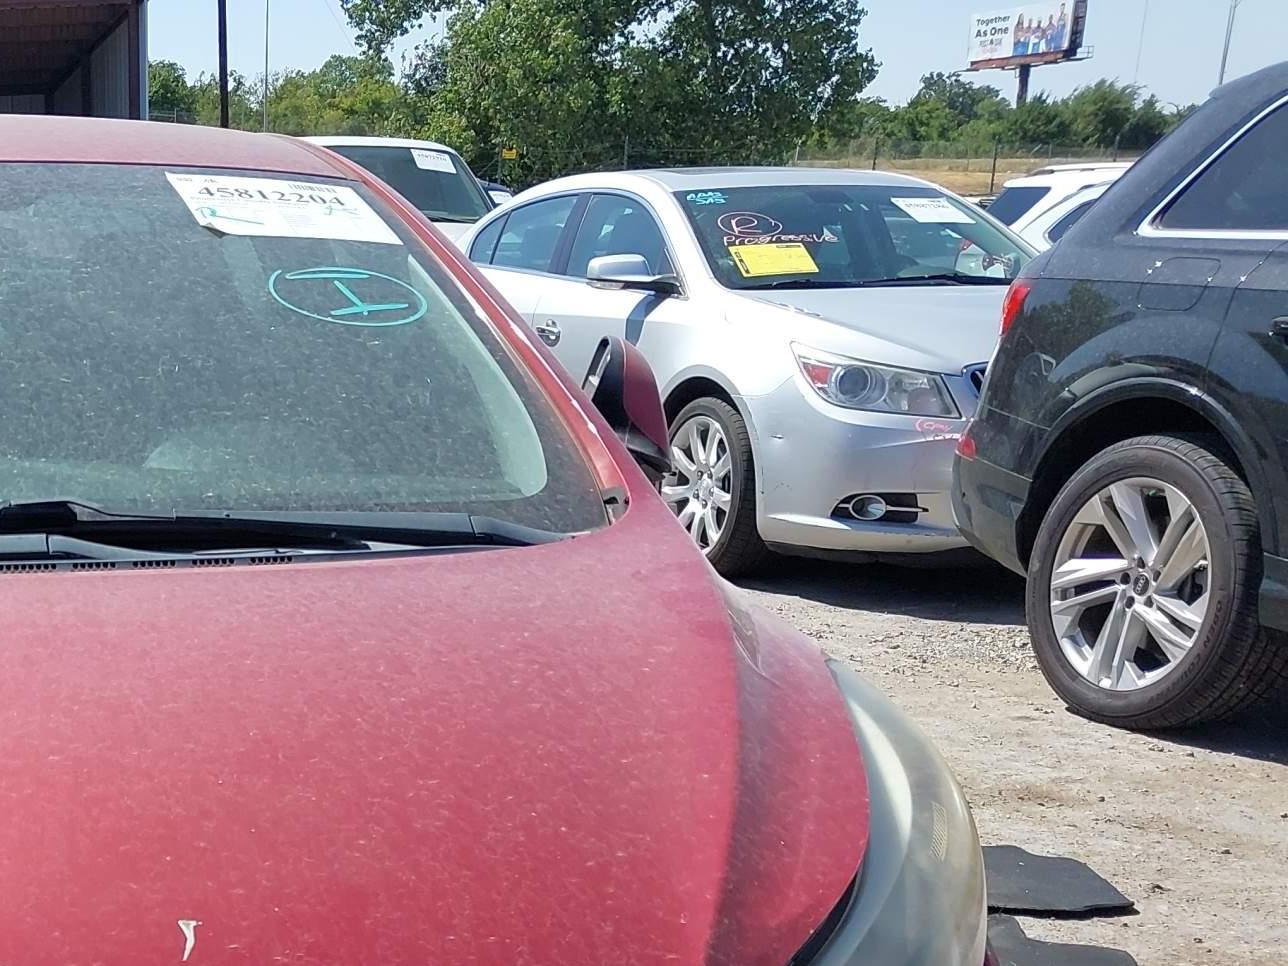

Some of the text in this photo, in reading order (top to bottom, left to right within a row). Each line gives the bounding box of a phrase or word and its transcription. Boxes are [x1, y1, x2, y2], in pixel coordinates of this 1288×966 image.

[976, 16, 1010, 26] Together
[975, 27, 1009, 38] As One
[198, 187, 344, 205] 45812204
[723, 233, 840, 247] Progressive
